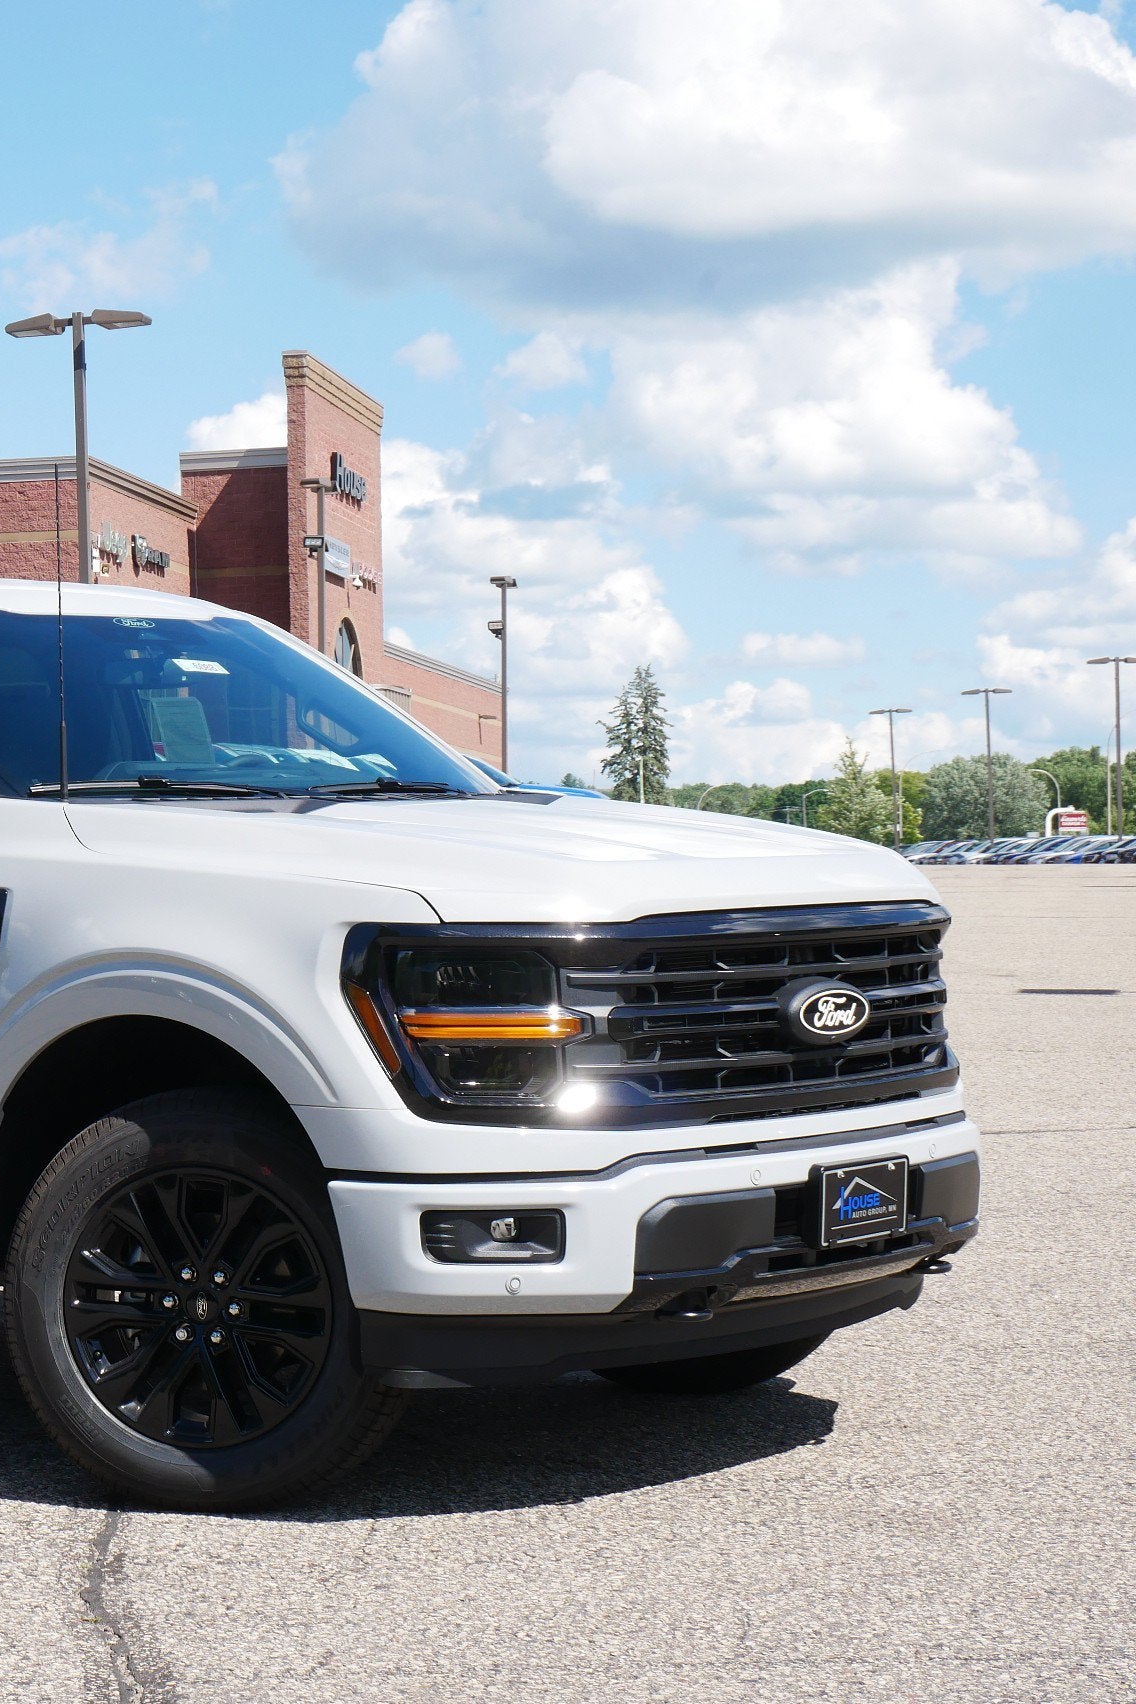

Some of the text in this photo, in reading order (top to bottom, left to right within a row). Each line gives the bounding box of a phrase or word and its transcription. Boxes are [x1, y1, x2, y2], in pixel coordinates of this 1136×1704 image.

[813, 996, 857, 1028] Ford
[840, 1186, 880, 1220] HOUSE
[851, 1209, 867, 1219] AUTO
